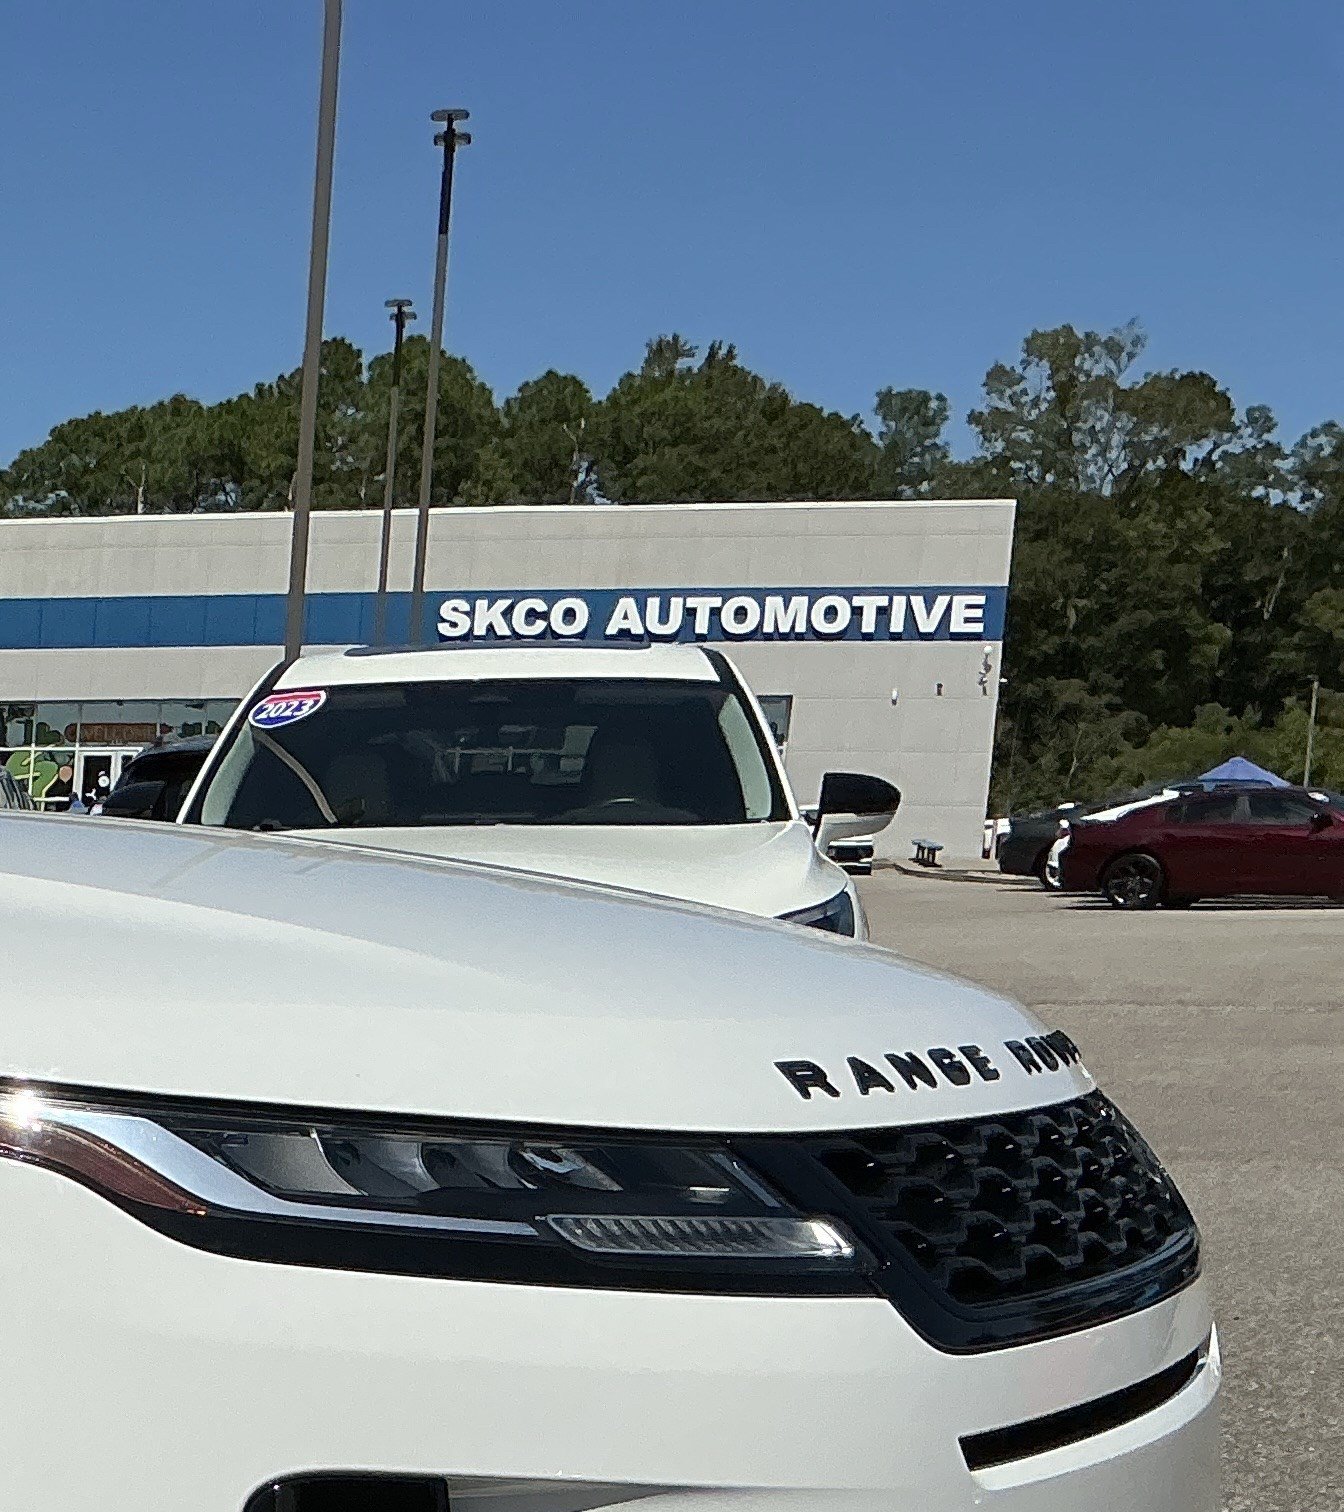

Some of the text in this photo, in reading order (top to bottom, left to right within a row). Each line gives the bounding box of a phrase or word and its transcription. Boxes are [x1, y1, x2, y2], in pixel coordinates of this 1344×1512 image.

[438, 595, 987, 637] SKCO AUTOMOTIVE
[255, 699, 314, 720] 2023
[774, 1045, 1000, 1100] RANGE
